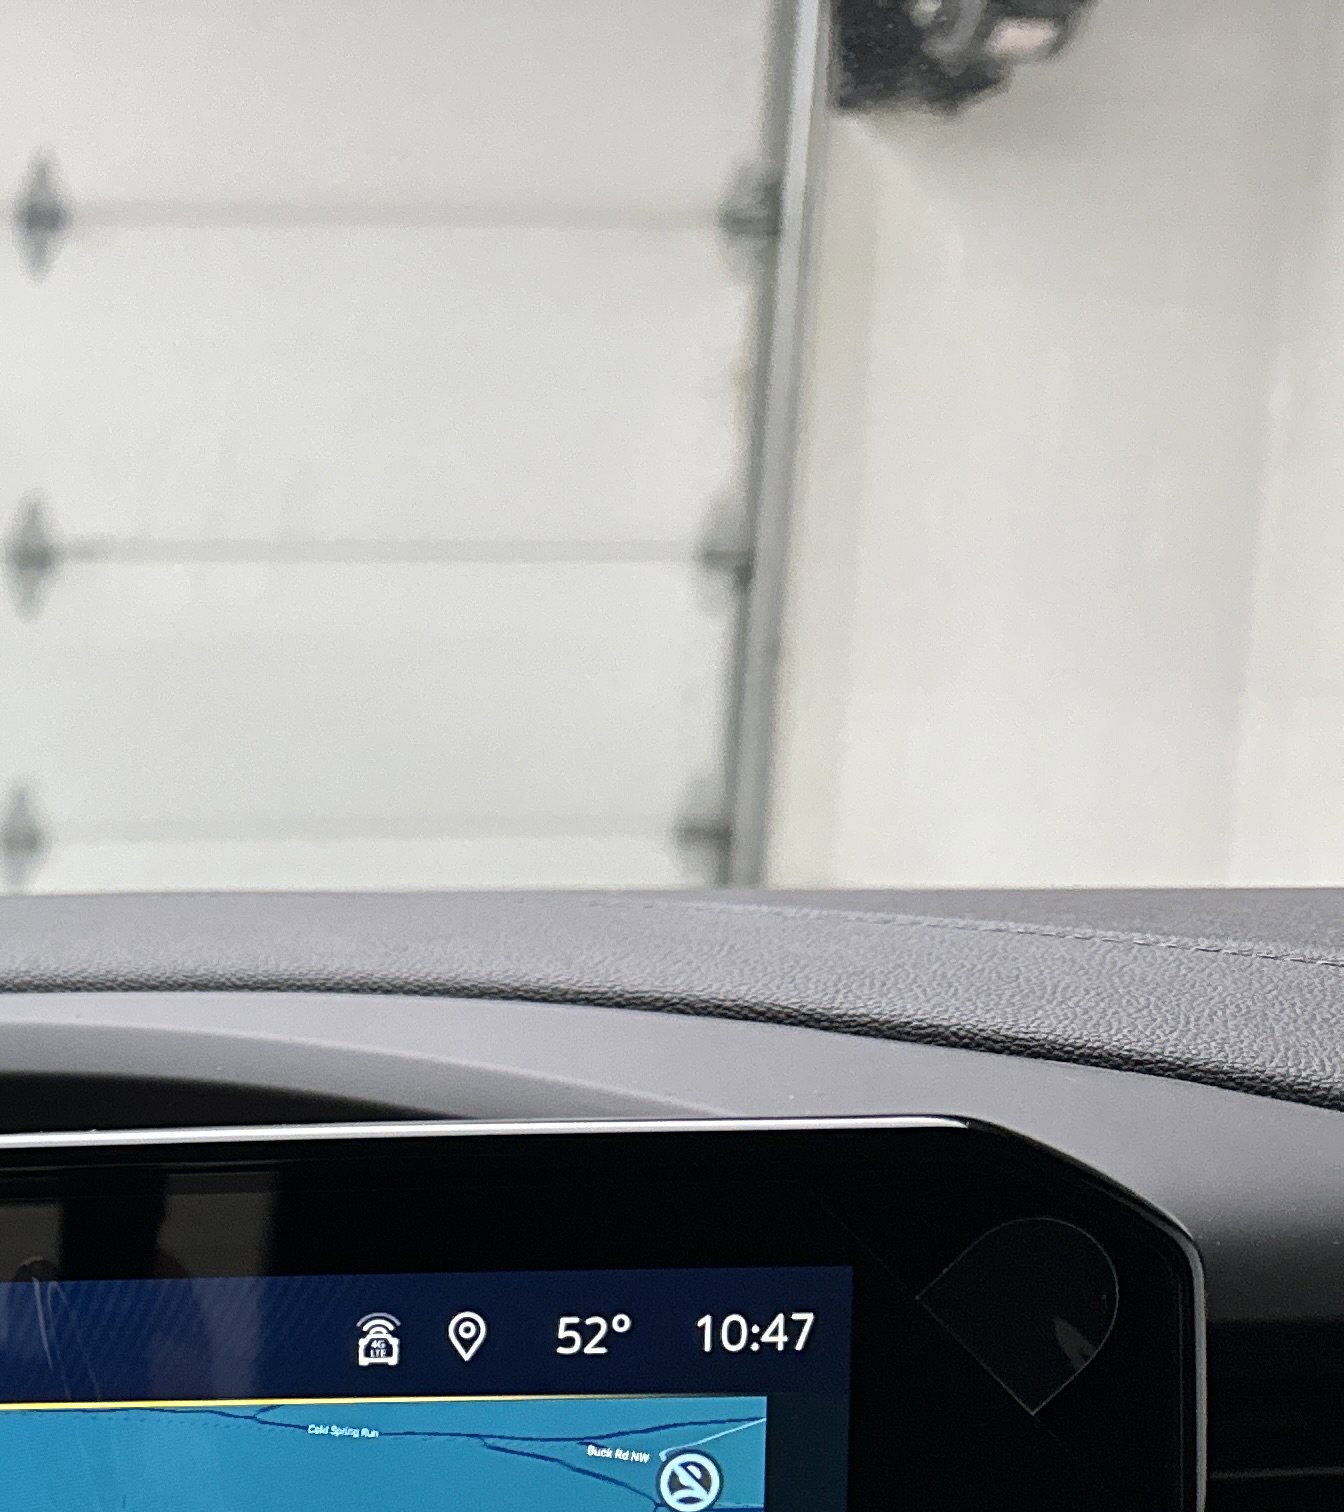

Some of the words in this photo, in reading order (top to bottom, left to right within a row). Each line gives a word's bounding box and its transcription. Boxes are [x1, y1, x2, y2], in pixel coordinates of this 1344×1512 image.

[556, 1313, 632, 1355] 52°
[697, 1312, 815, 1353] 10:47
[614, 1448, 629, 1462] Rd
[630, 1450, 650, 1464] NW
